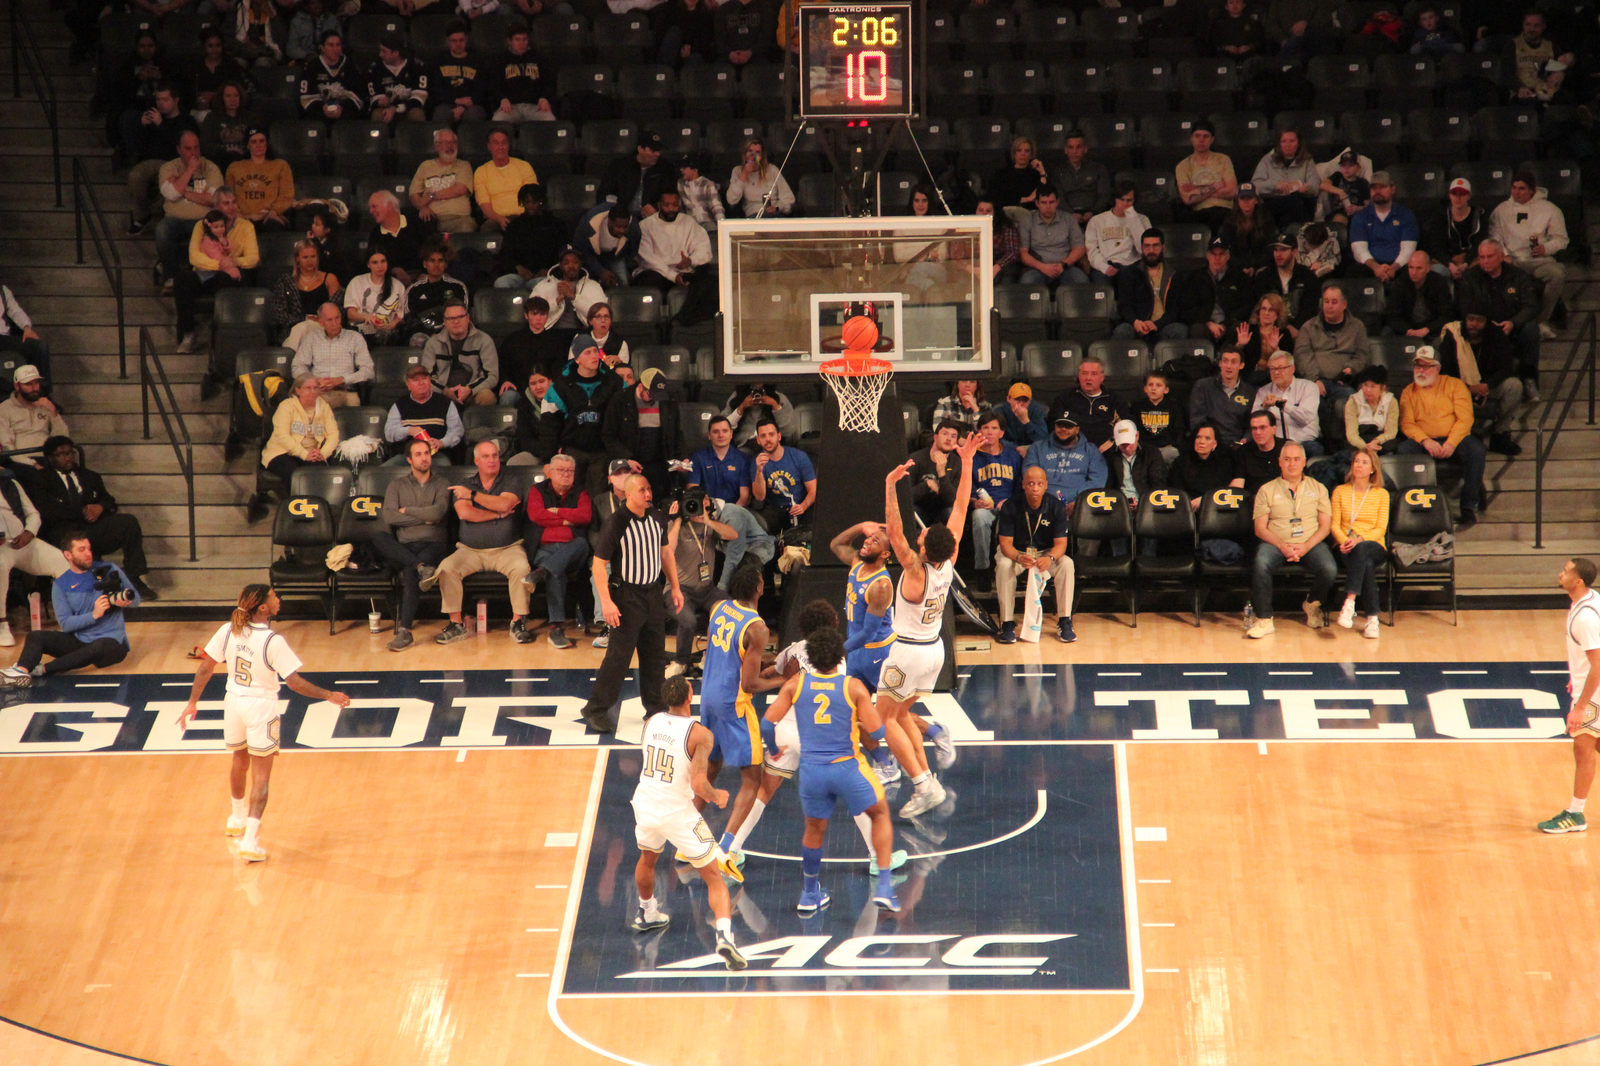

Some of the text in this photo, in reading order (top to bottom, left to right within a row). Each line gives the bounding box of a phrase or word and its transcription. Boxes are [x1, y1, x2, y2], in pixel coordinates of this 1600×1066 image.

[832, 17, 898, 46] 2:06
[419, 75, 428, 89] 9
[846, 51, 887, 101] 10
[236, 174, 272, 187] GEORGIA
[244, 191, 265, 200] TECH
[1141, 414, 1170, 427] SWARM
[288, 498, 319, 518] GT
[351, 497, 382, 516] GT
[1086, 491, 1117, 511] GT
[1149, 490, 1179, 509] GT
[1213, 489, 1243, 508] GT
[1405, 489, 1436, 508] GT
[711, 615, 736, 653] 33
[236, 644, 255, 657] SMITH
[234, 656, 253, 687] 5
[813, 693, 832, 724] 2
[652, 733, 676, 746] MOORE
[644, 744, 674, 783] 14
[655, 934, 1078, 968] ACC
